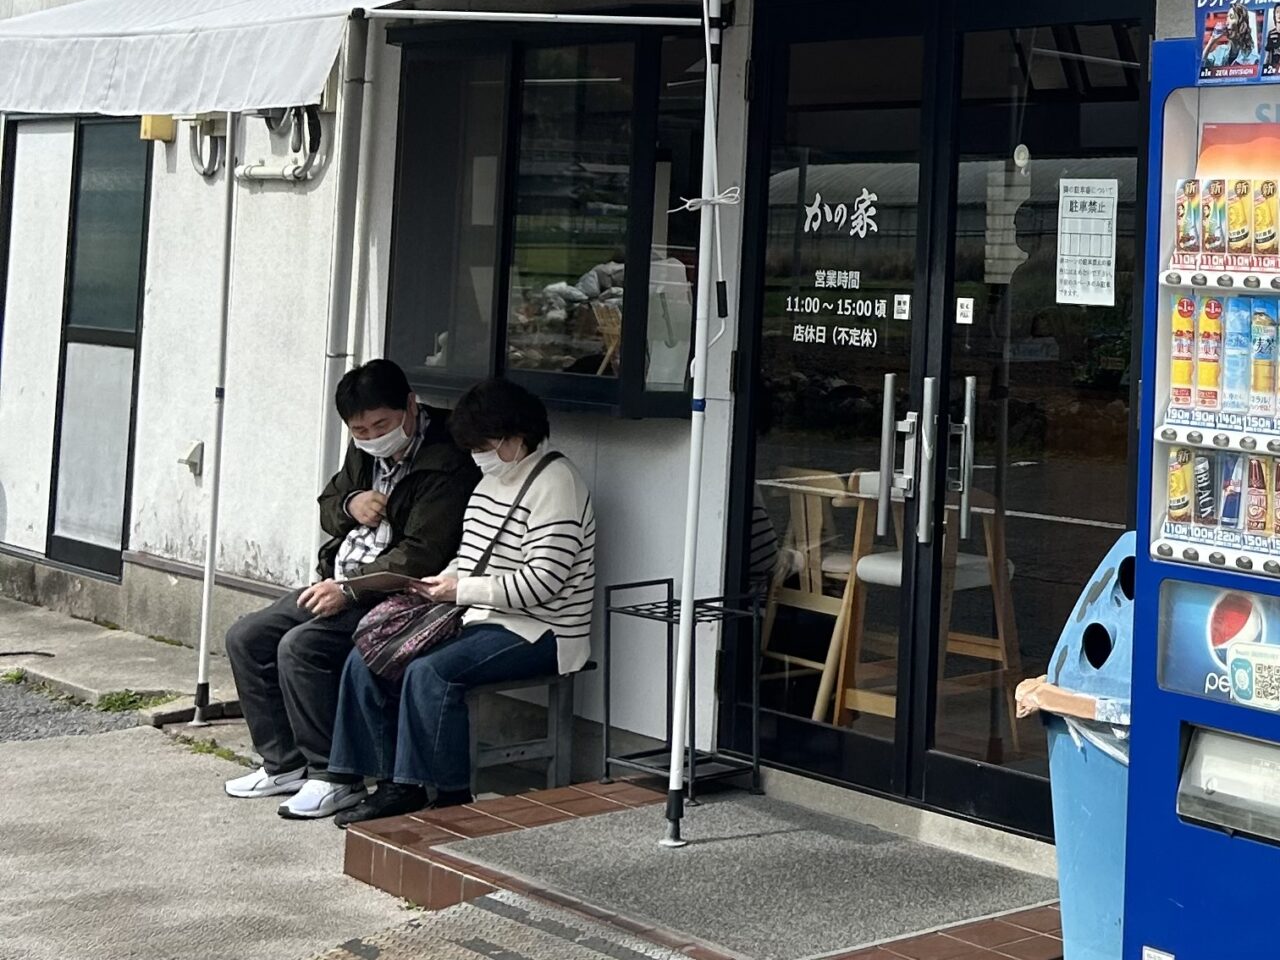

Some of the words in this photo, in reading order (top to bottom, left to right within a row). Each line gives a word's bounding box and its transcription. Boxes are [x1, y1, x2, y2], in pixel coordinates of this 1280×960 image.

[803, 187, 879, 239] かの家
[1069, 200, 1106, 214] 駐車禁止
[814, 270, 861, 290] 営業時間
[1197, 473, 1215, 518] BLACK
